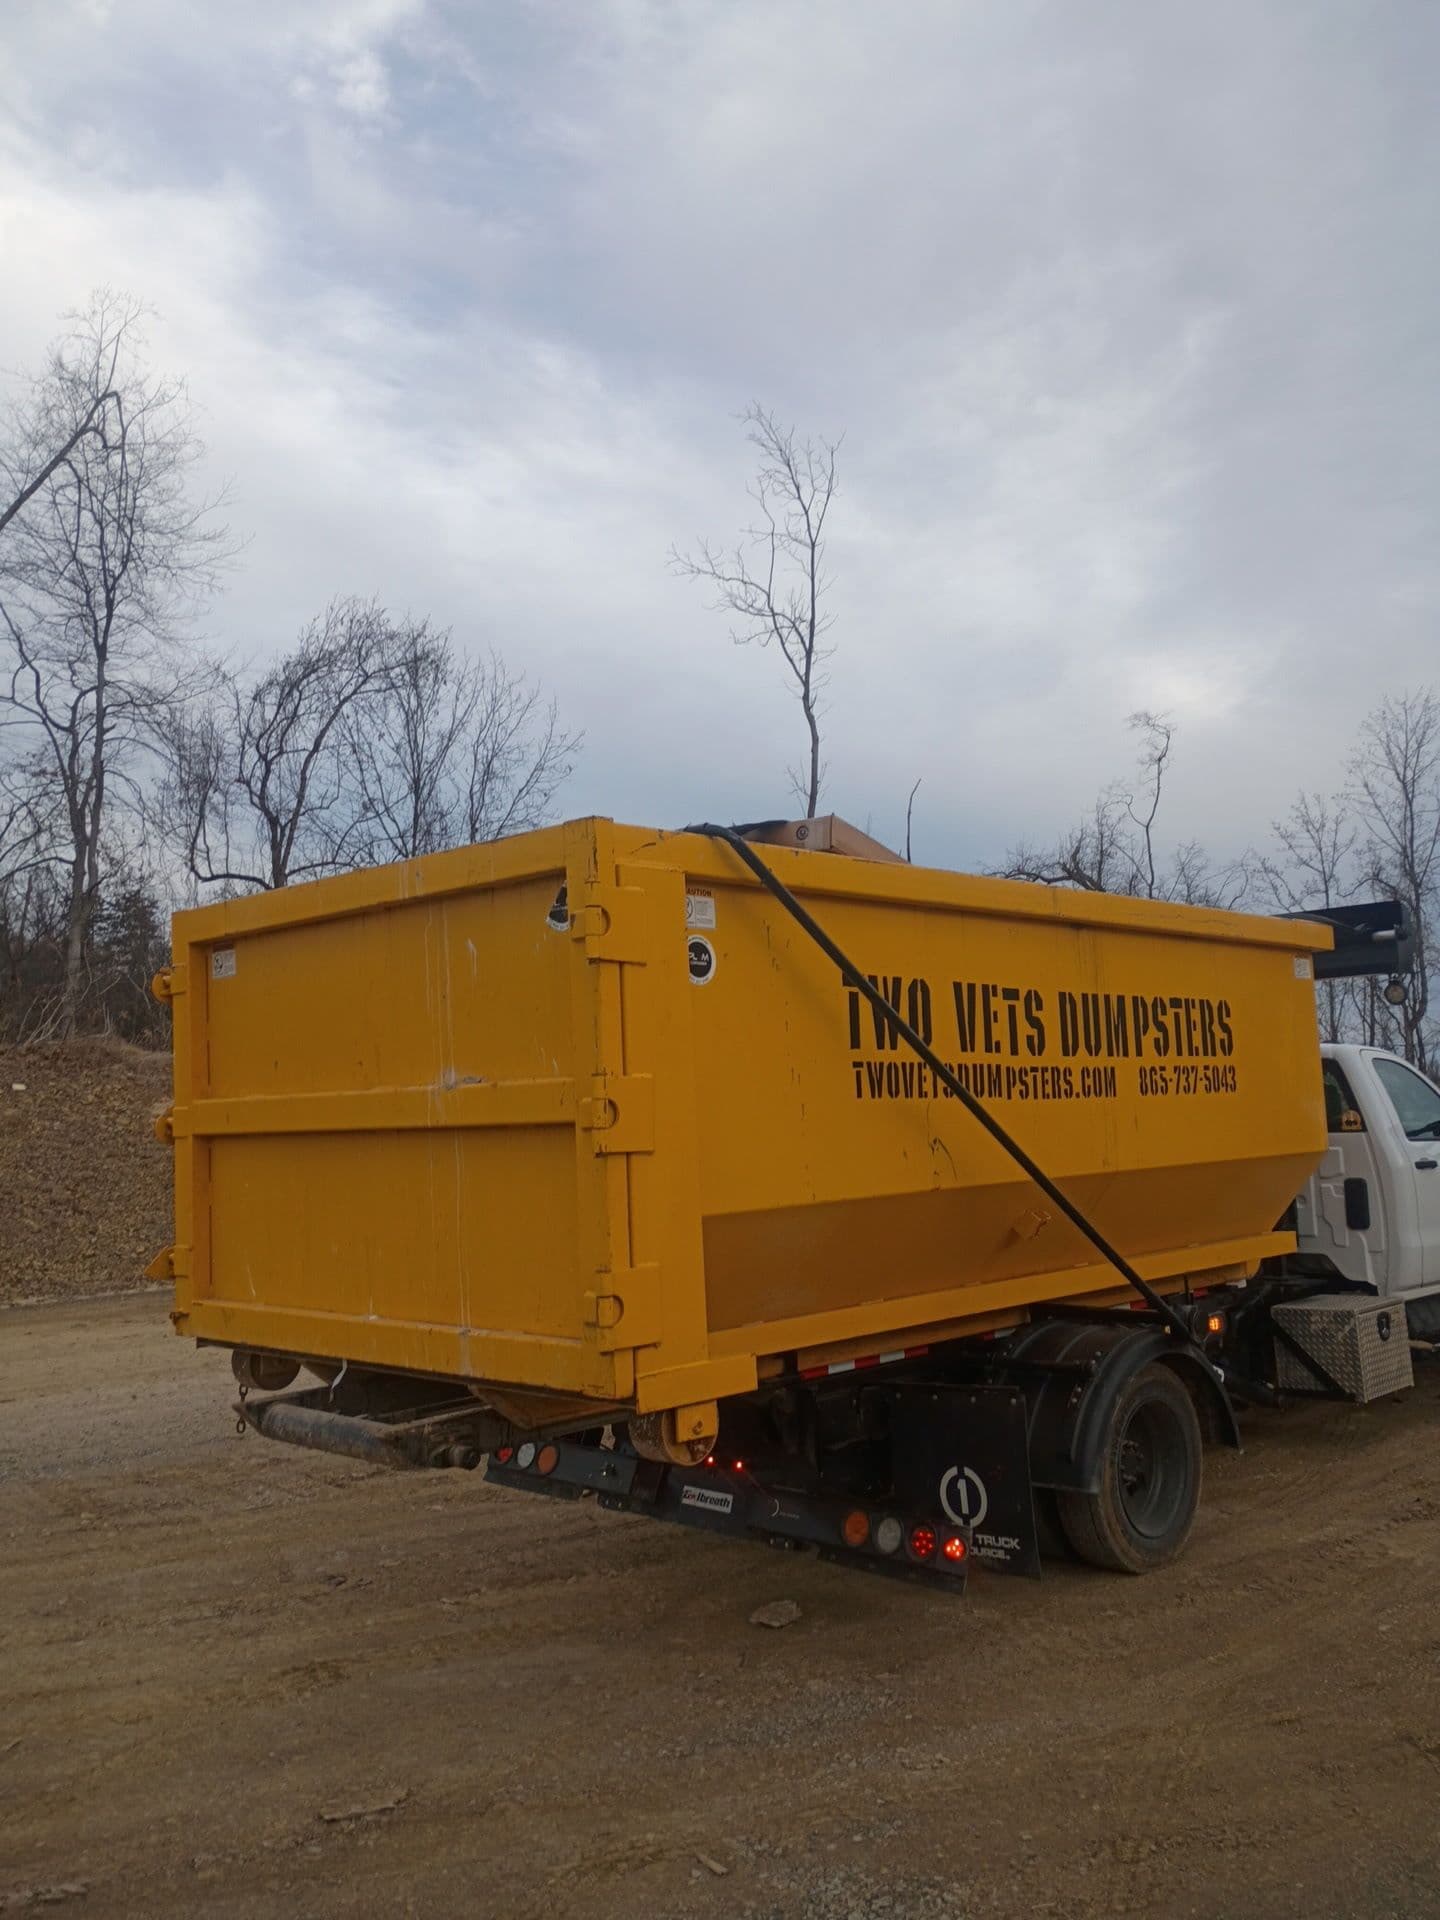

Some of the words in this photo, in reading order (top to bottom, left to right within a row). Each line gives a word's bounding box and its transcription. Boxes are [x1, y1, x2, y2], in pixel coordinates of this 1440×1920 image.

[686, 887, 712, 897] AUTION
[842, 972, 932, 1051] TWO
[953, 981, 1046, 1057] VETS
[1058, 991, 1234, 1058] DUMPSTERS
[852, 1060, 1117, 1100] TWOVETSDUMPSTERS.COM
[1138, 1064, 1238, 1096] 865-737-5043
[975, 1534, 1021, 1550] TRUCK
